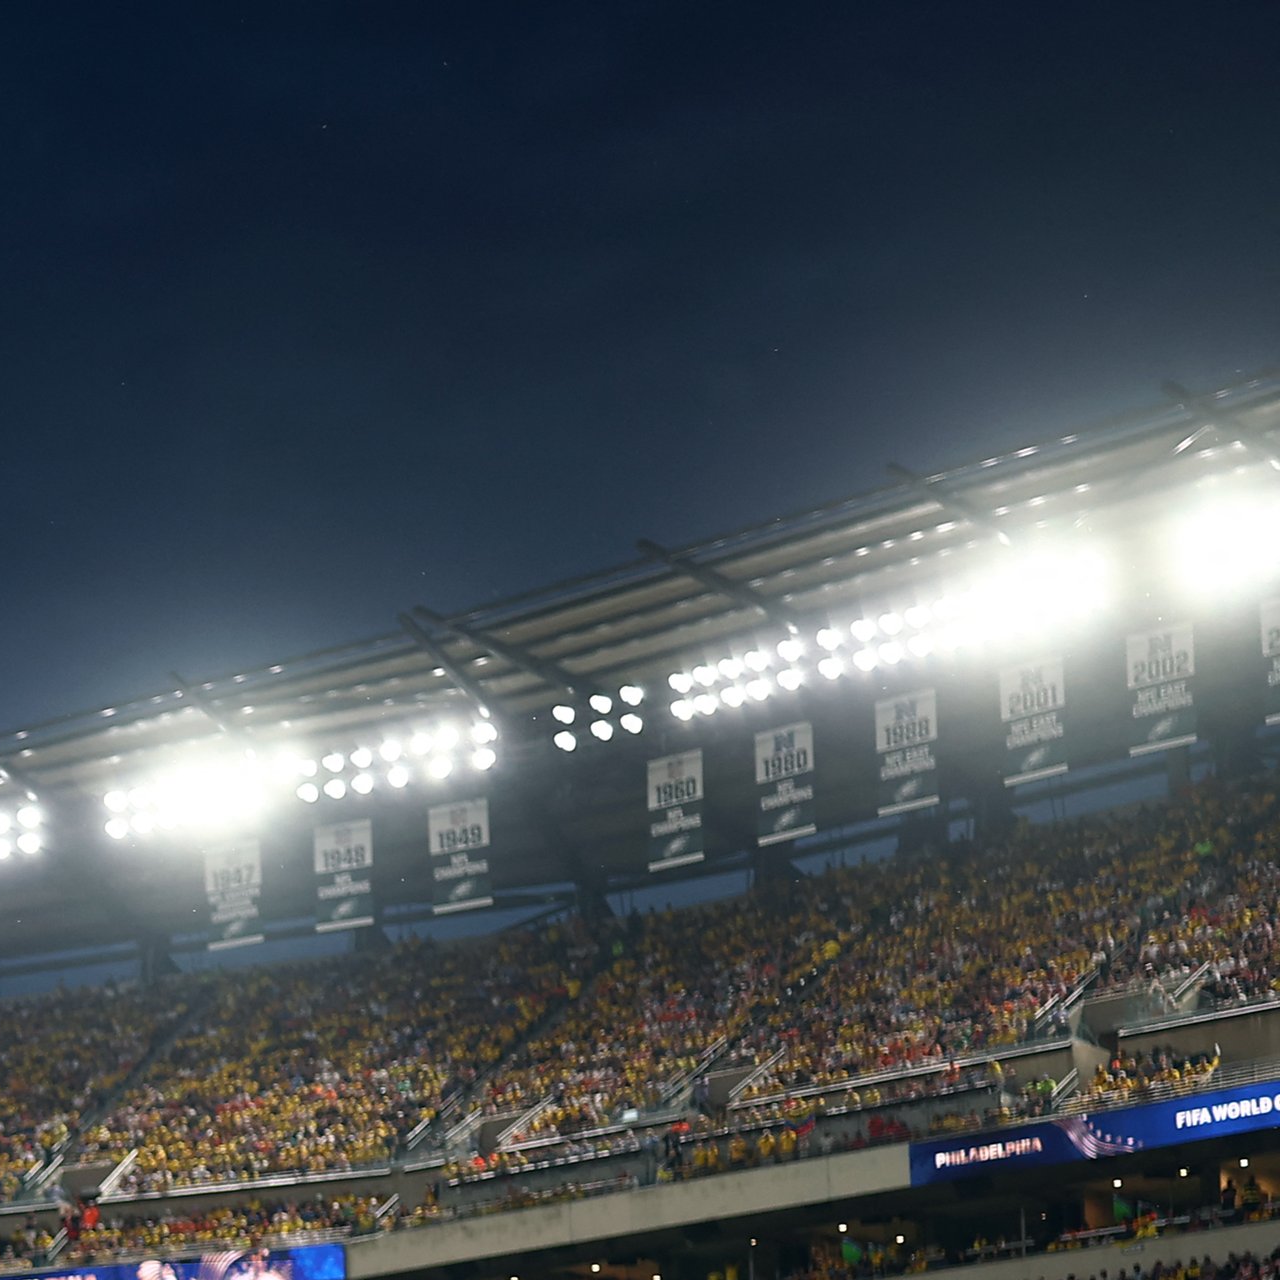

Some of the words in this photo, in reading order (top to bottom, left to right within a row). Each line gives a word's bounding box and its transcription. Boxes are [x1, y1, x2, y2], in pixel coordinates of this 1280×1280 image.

[1176, 1108, 1211, 1130] FIFA
[1213, 1096, 1272, 1122] WORLD
[934, 1136, 1042, 1169] PHILADELPHIA
